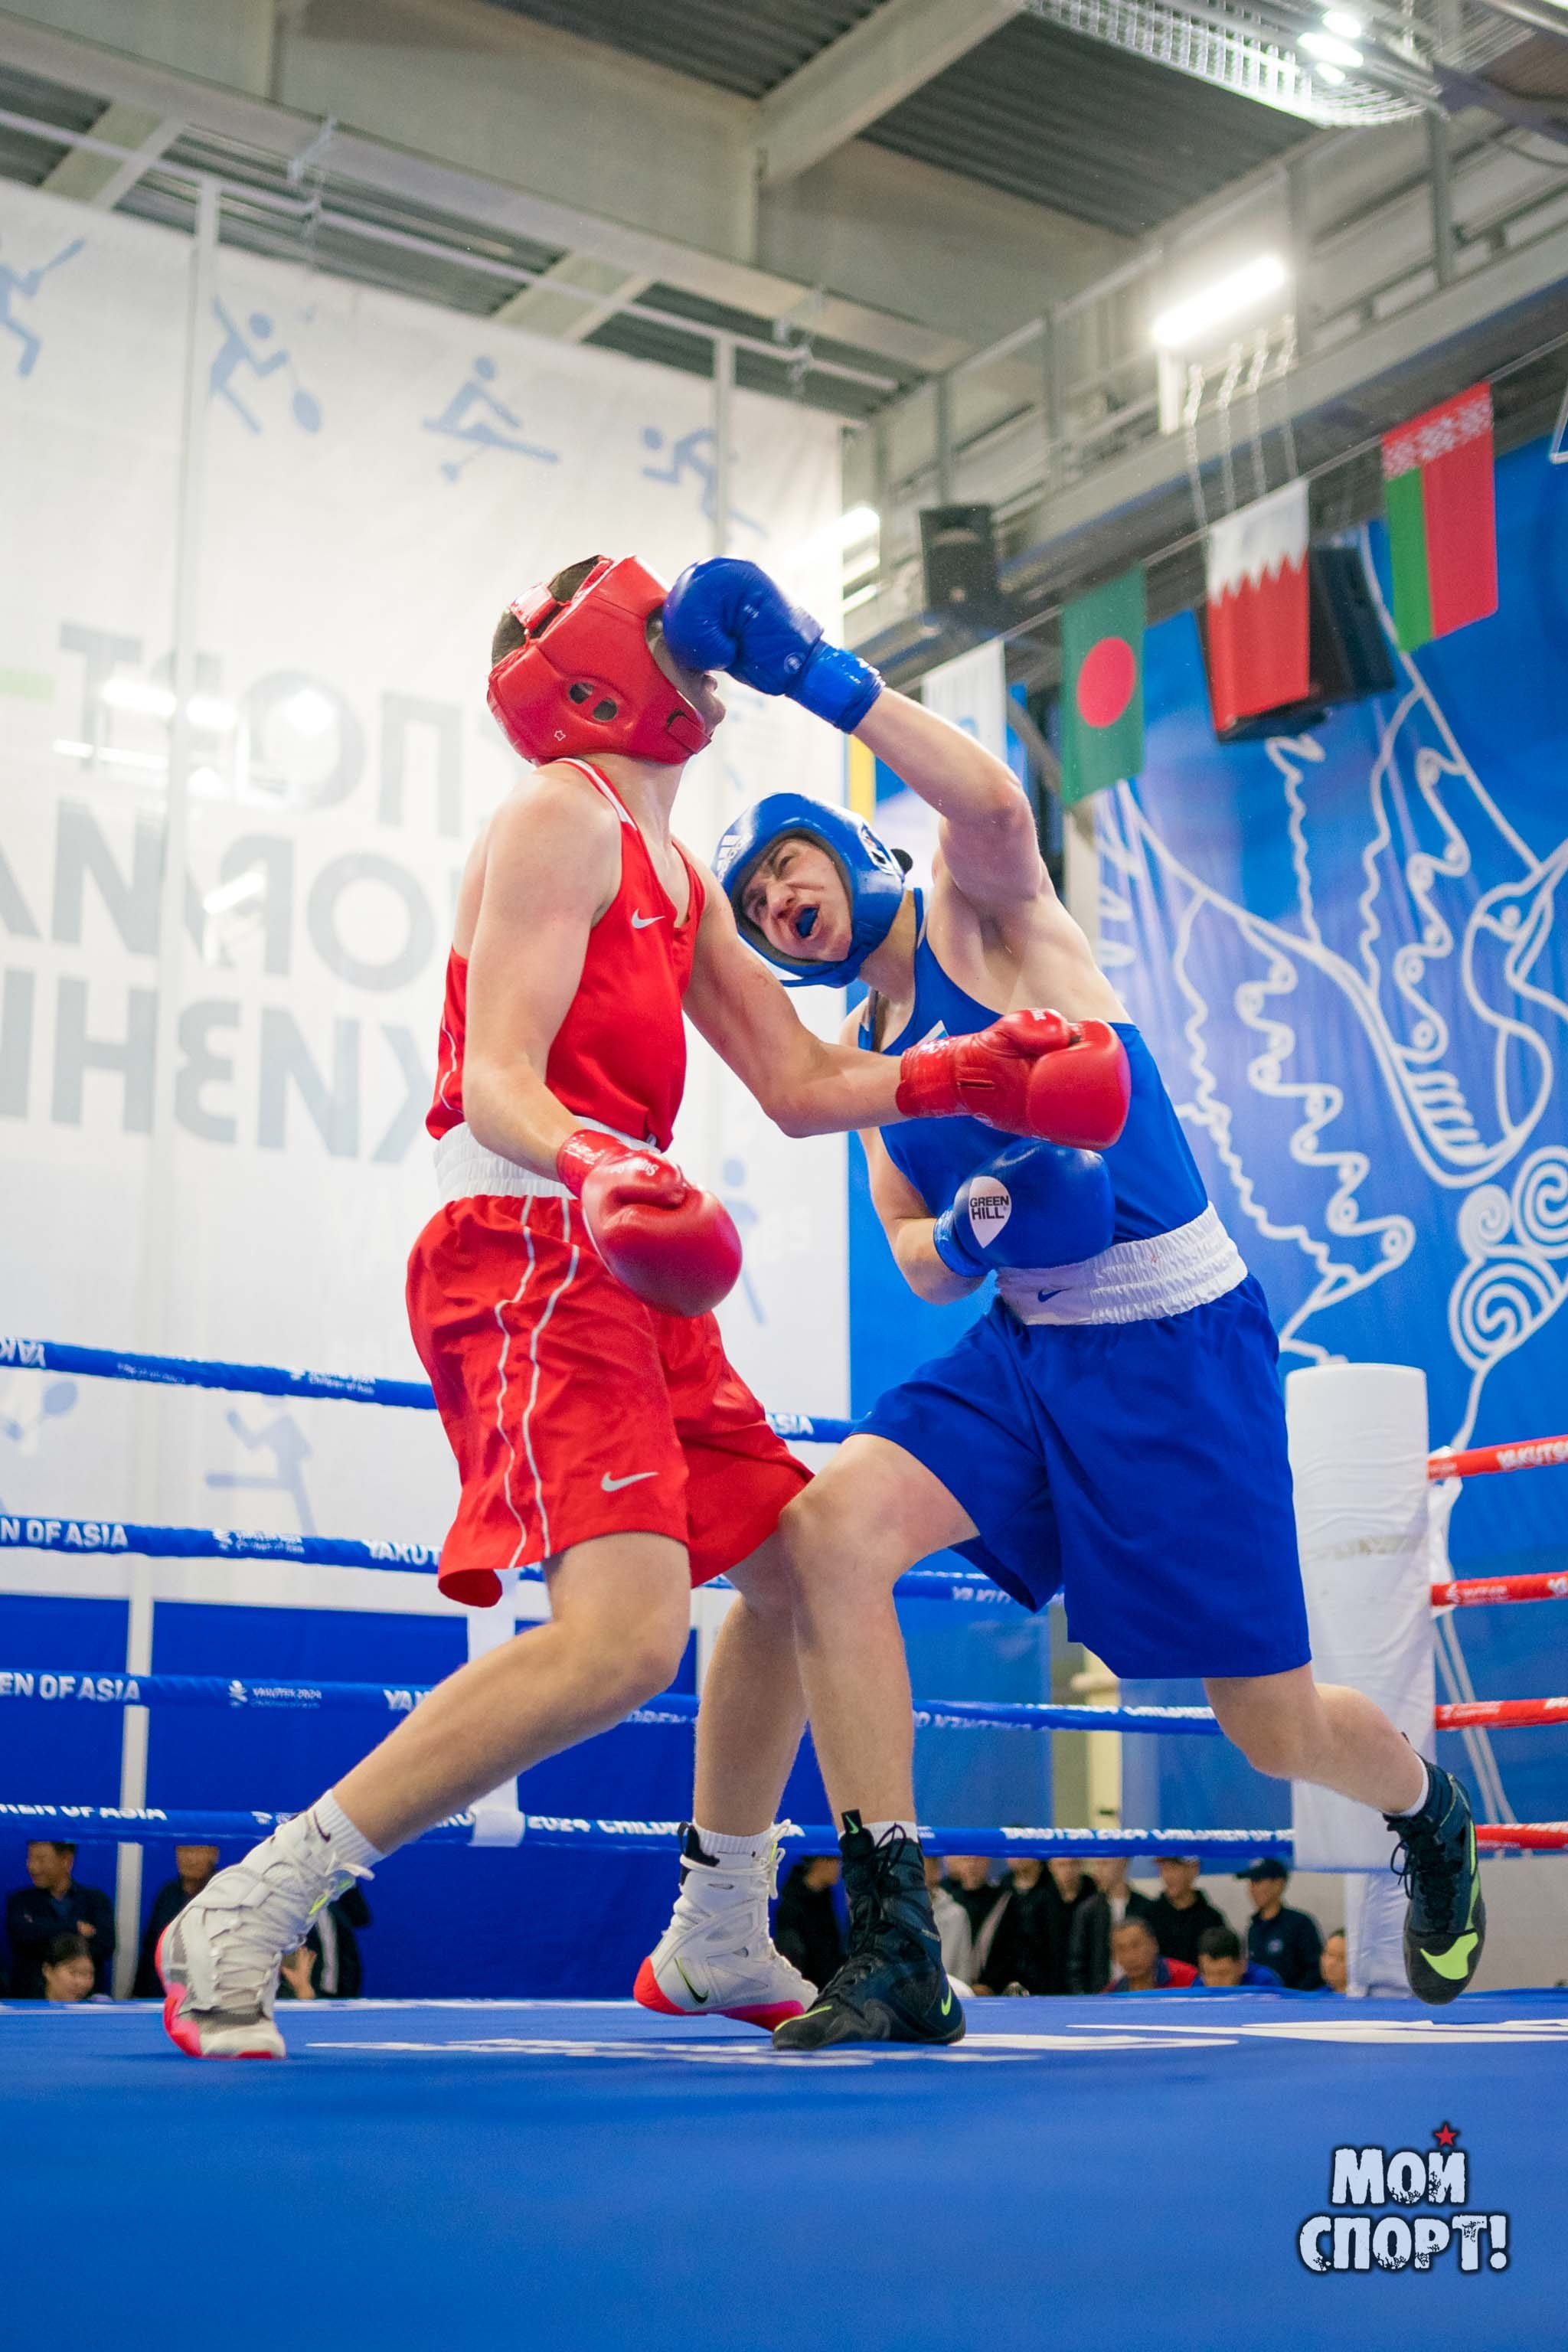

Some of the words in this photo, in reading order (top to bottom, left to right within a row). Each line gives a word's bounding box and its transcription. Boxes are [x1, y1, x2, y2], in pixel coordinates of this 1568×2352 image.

[970, 1195, 1009, 1207] GREEN
[972, 1206, 1004, 1220] HILL
[26, 1520, 61, 1545] OF
[64, 1523, 129, 1548] ASIA
[39, 1674, 76, 1700] OF
[77, 1677, 140, 1702] ASIA
